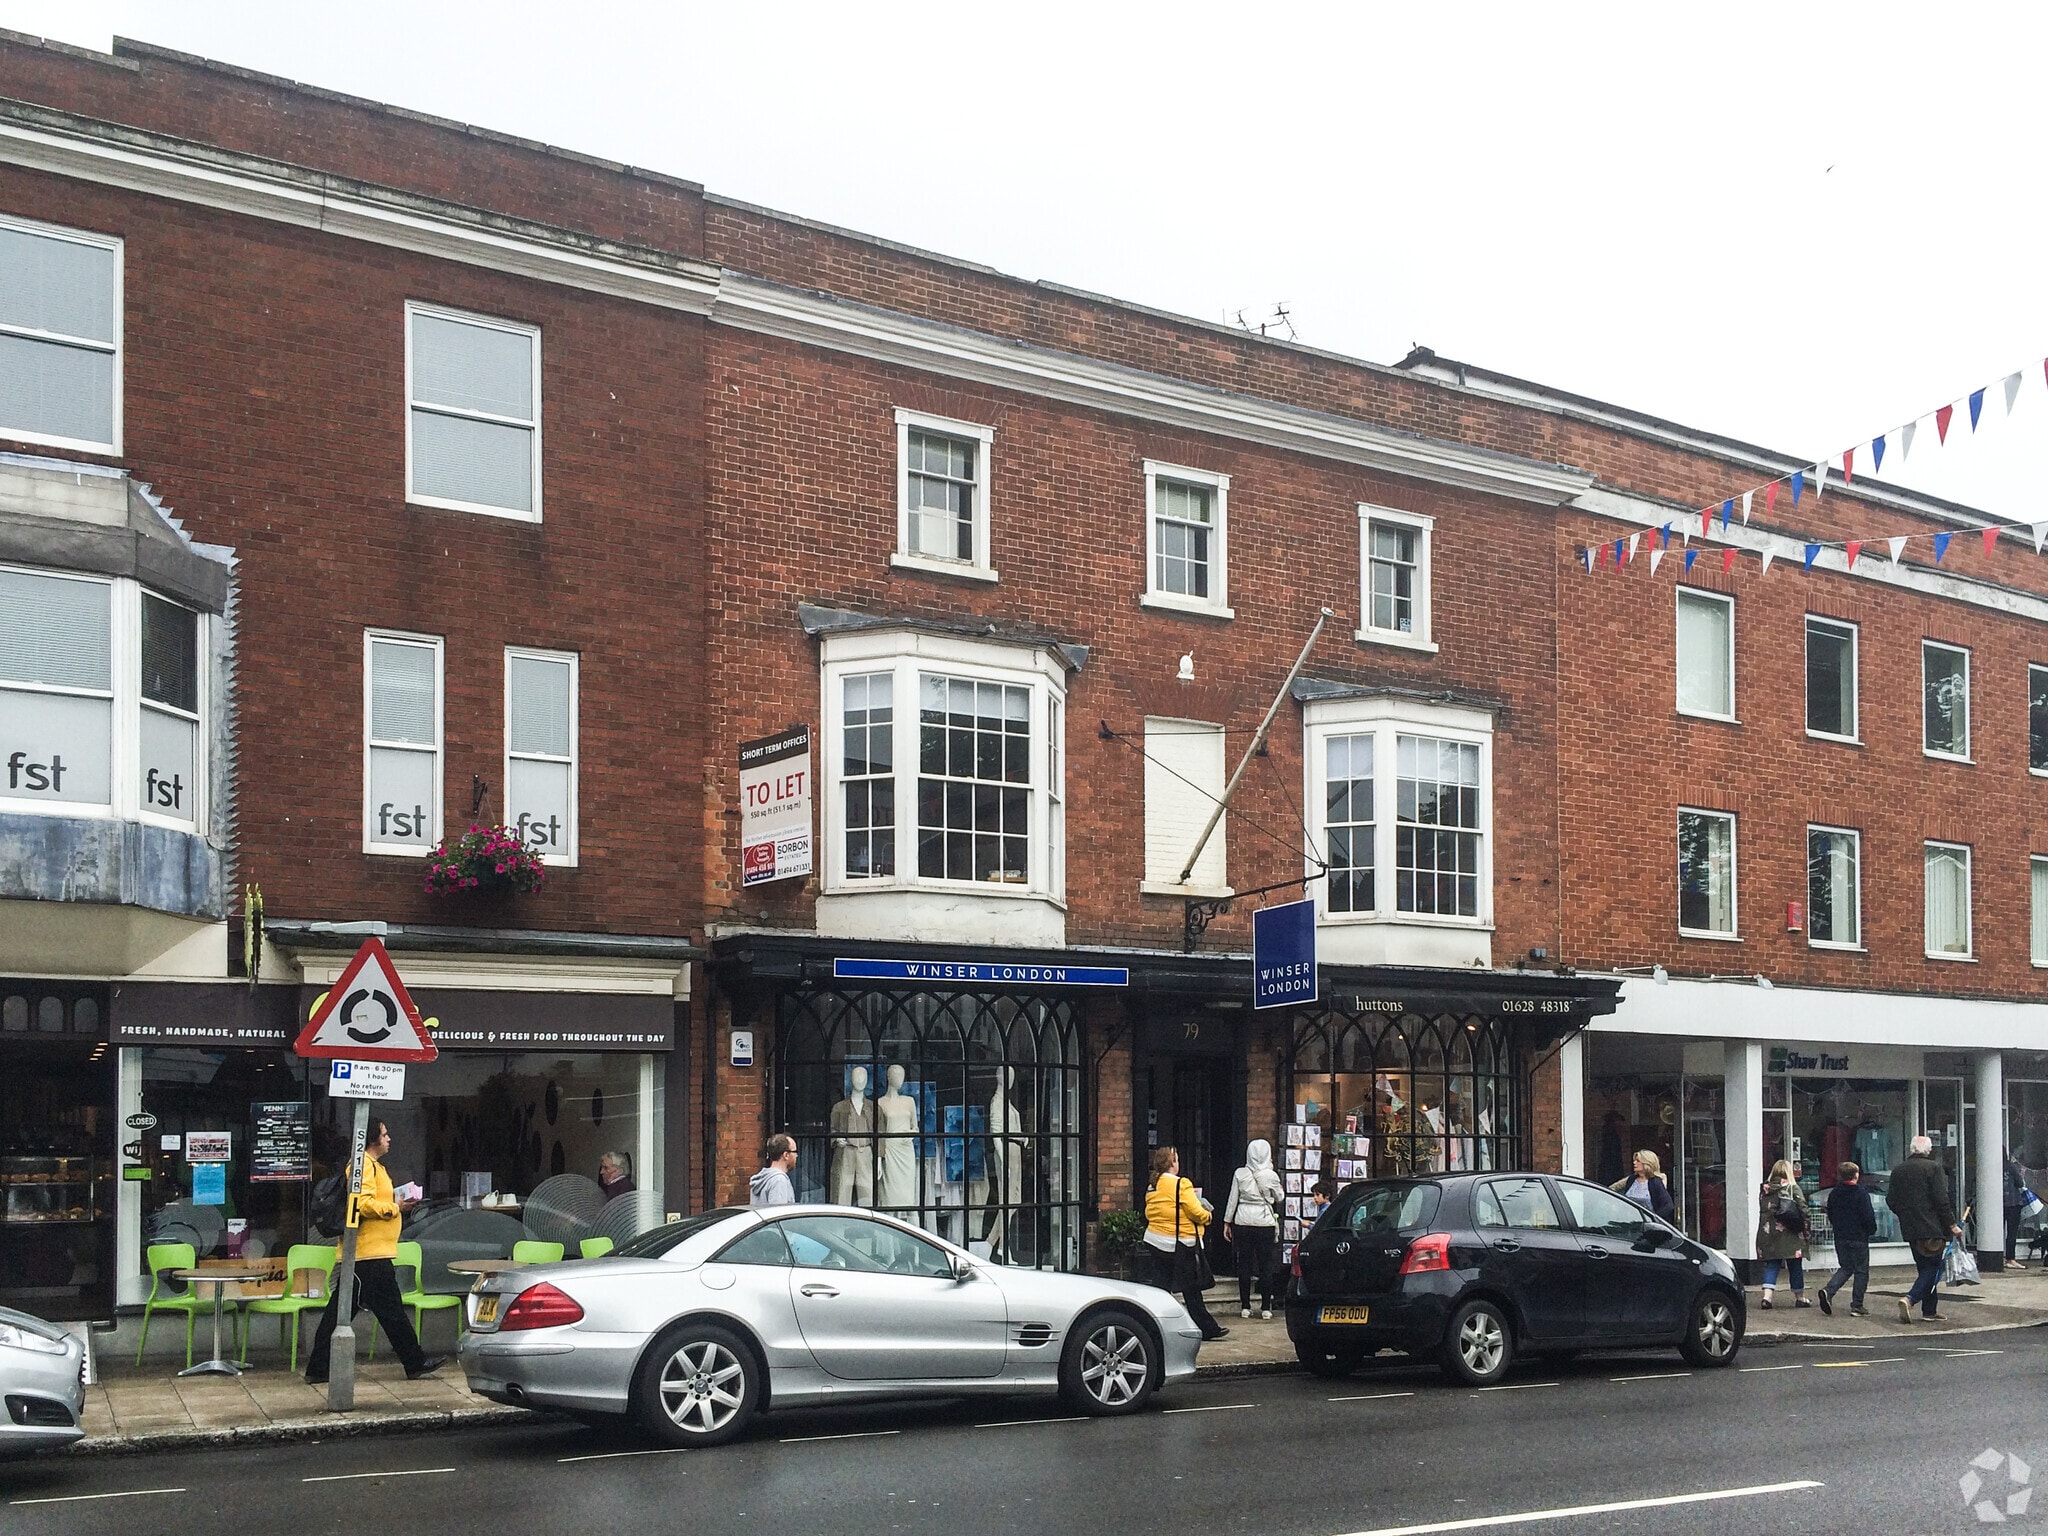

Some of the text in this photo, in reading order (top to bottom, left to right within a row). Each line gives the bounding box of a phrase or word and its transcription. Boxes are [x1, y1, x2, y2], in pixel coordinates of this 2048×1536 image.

[742, 734, 807, 760] SHORT TERM OFFICES
[7, 752, 67, 792] fst
[147, 768, 183, 810] fst
[746, 771, 805, 807] TO LET
[378, 803, 426, 838] fst
[516, 812, 561, 847] fst
[777, 840, 809, 855] SORBON
[906, 964, 1066, 981] WINSER LONDON
[1260, 962, 1310, 996] WINSER LONDON
[1355, 995, 1404, 1012] huttons
[1502, 1000, 1535, 1012] 01628
[121, 1026, 287, 1038] FRESH, HANDMADE, NATURAL
[431, 1031, 665, 1043] DELICIOUS & FRESH FOOD THROUGHOUT THE DAY
[1182, 1022, 1199, 1040] 79
[1786, 1052, 1849, 1071] Shaw Trust
[337, 1063, 349, 1078] P
[127, 1117, 154, 1126] CLOSED
[1323, 1308, 1347, 1320] FP56
